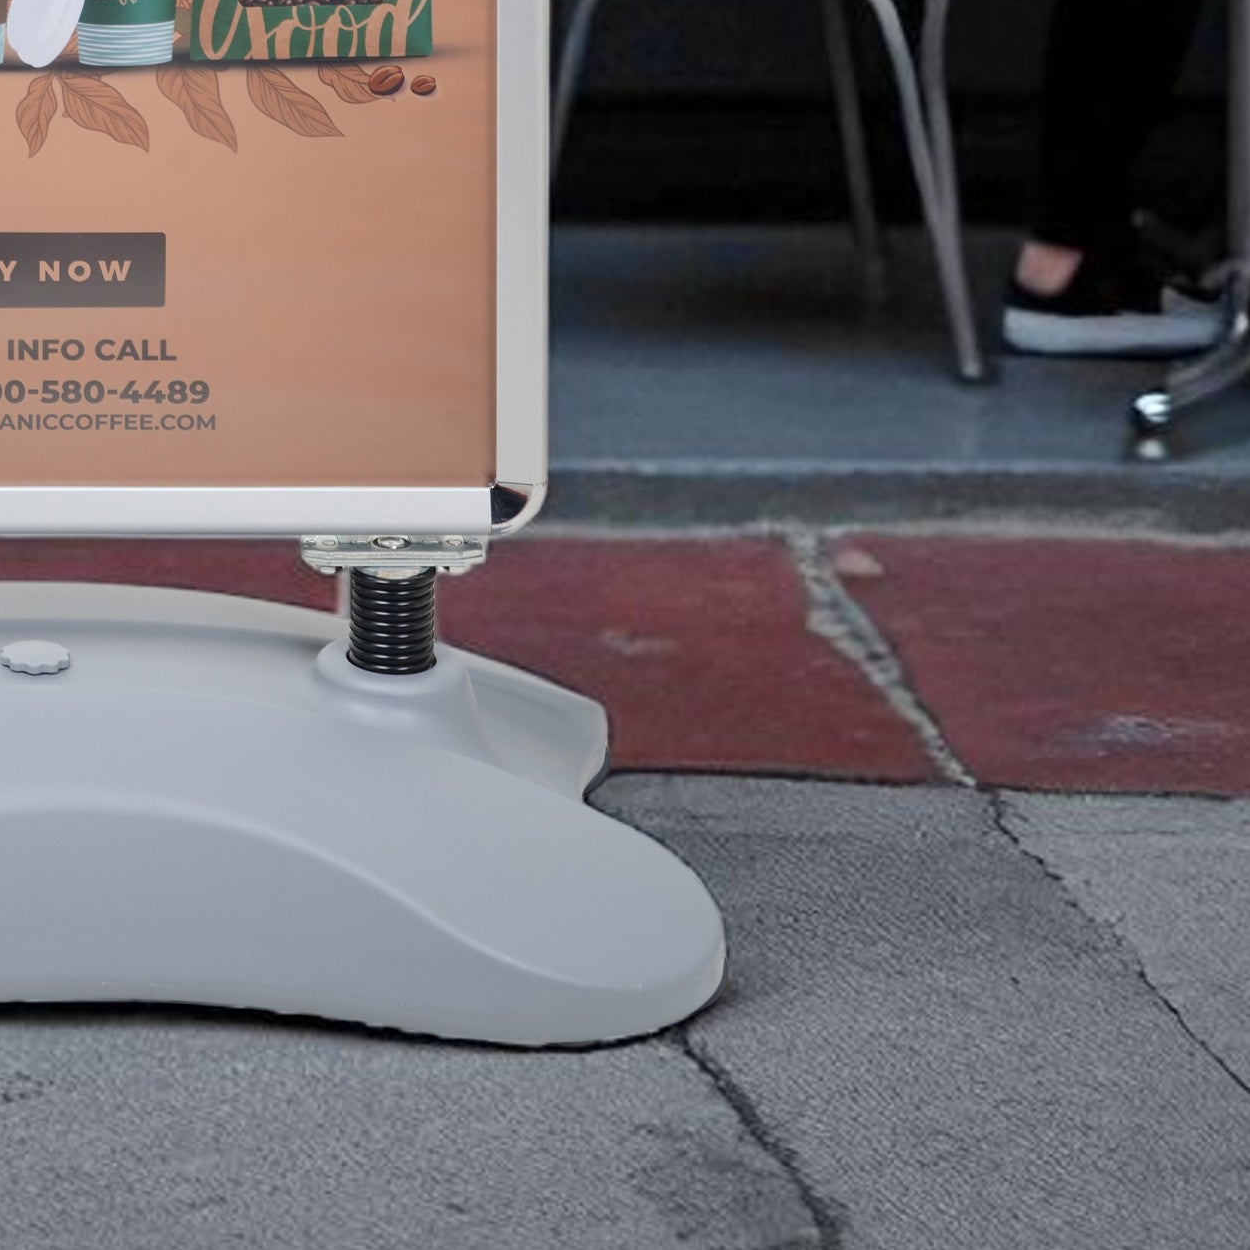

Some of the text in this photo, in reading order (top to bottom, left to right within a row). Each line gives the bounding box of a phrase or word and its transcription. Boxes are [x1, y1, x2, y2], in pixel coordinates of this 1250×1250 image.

[38, 259, 132, 282] NOW
[7, 339, 85, 361] INFO
[94, 339, 177, 361] CALL
